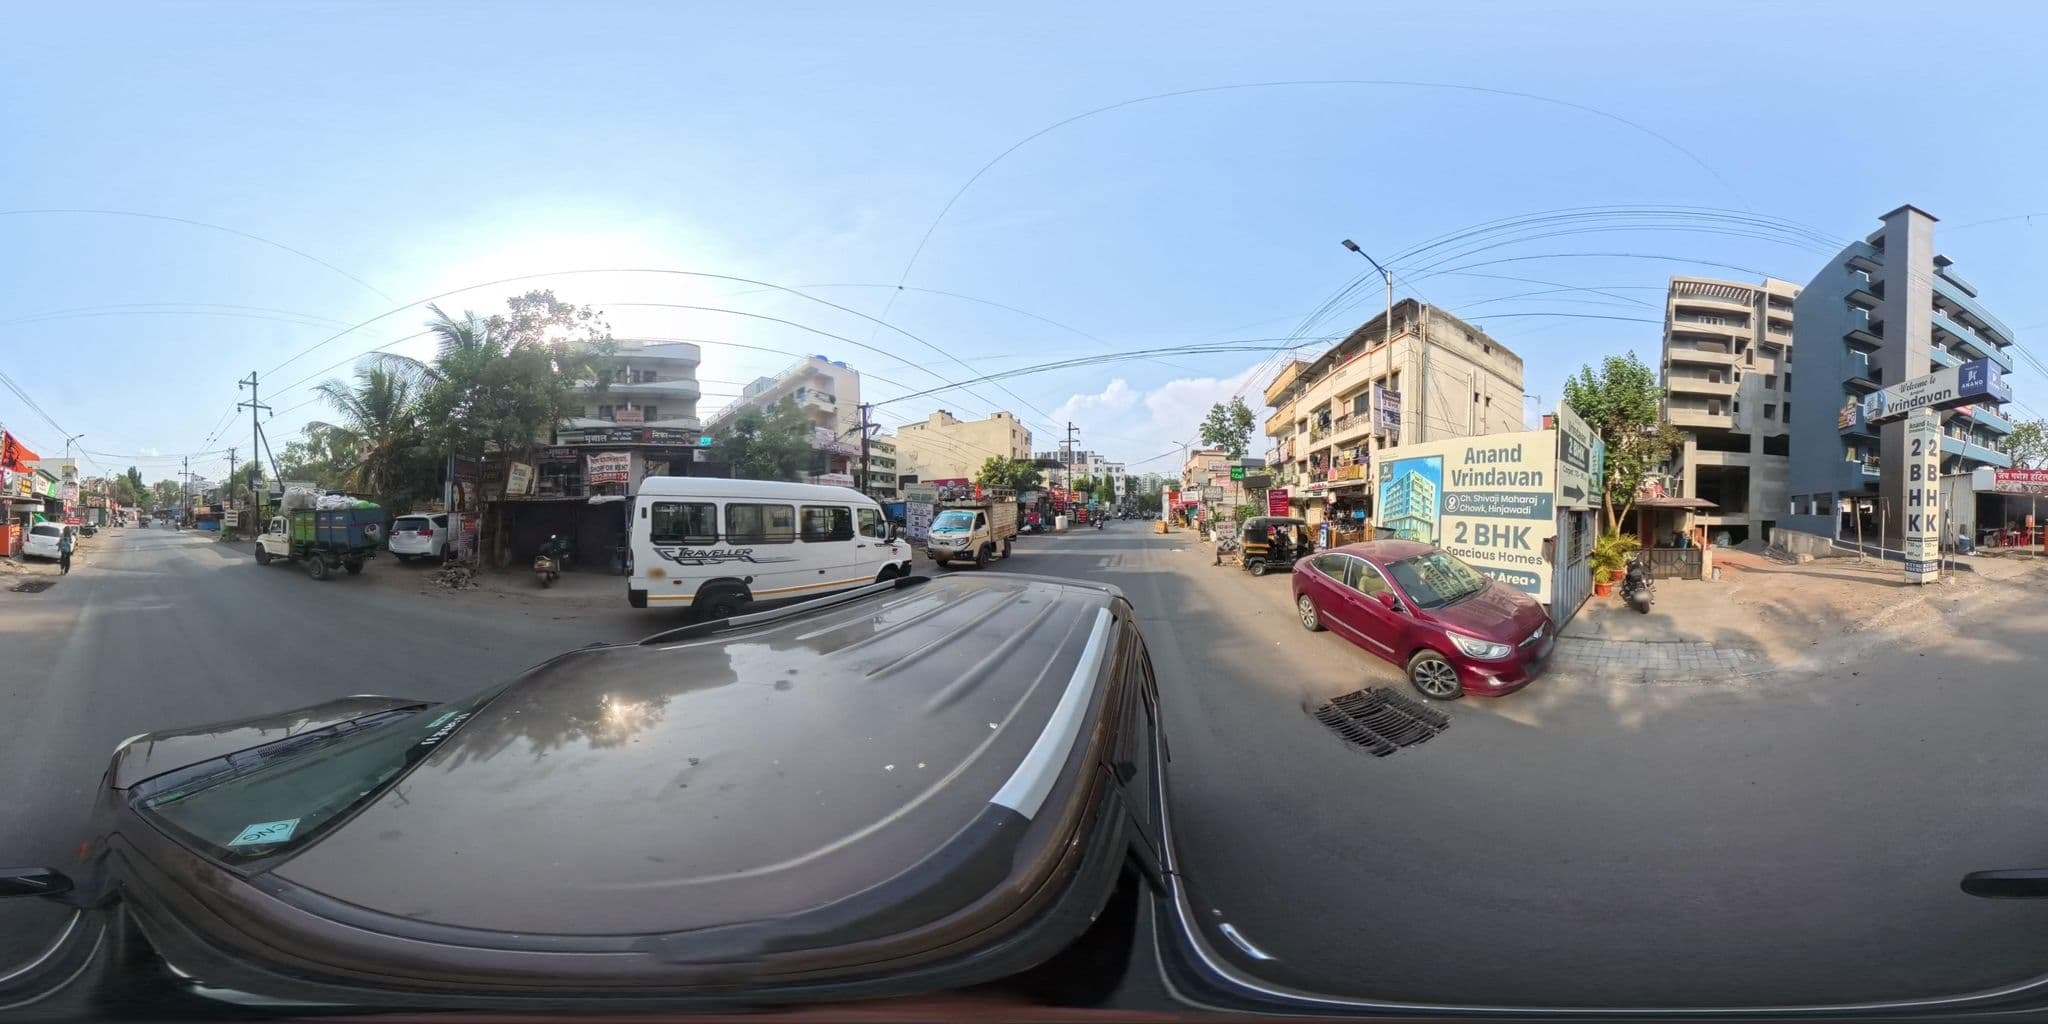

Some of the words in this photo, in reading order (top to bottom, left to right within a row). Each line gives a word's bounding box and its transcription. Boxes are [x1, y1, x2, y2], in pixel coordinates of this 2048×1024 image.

[1887, 388, 1952, 413] Vrindavan
[1464, 444, 1522, 465] Anand
[1911, 438, 1921, 457] 2
[1928, 439, 1937, 457] 2
[1451, 467, 1543, 488] Vrindavan
[1473, 494, 1500, 505] Shivaji
[1500, 495, 1538, 506] Maharaj
[1488, 505, 1531, 515] Hinjawadi
[1455, 521, 1468, 544] 2
[1474, 523, 1532, 551] BHK
[679, 547, 753, 558] TRAVELLER
[1446, 546, 1496, 561] Spacious
[1498, 552, 1543, 565] Homes
[1498, 572, 1529, 586] Area
[243, 823, 289, 841] CNG
